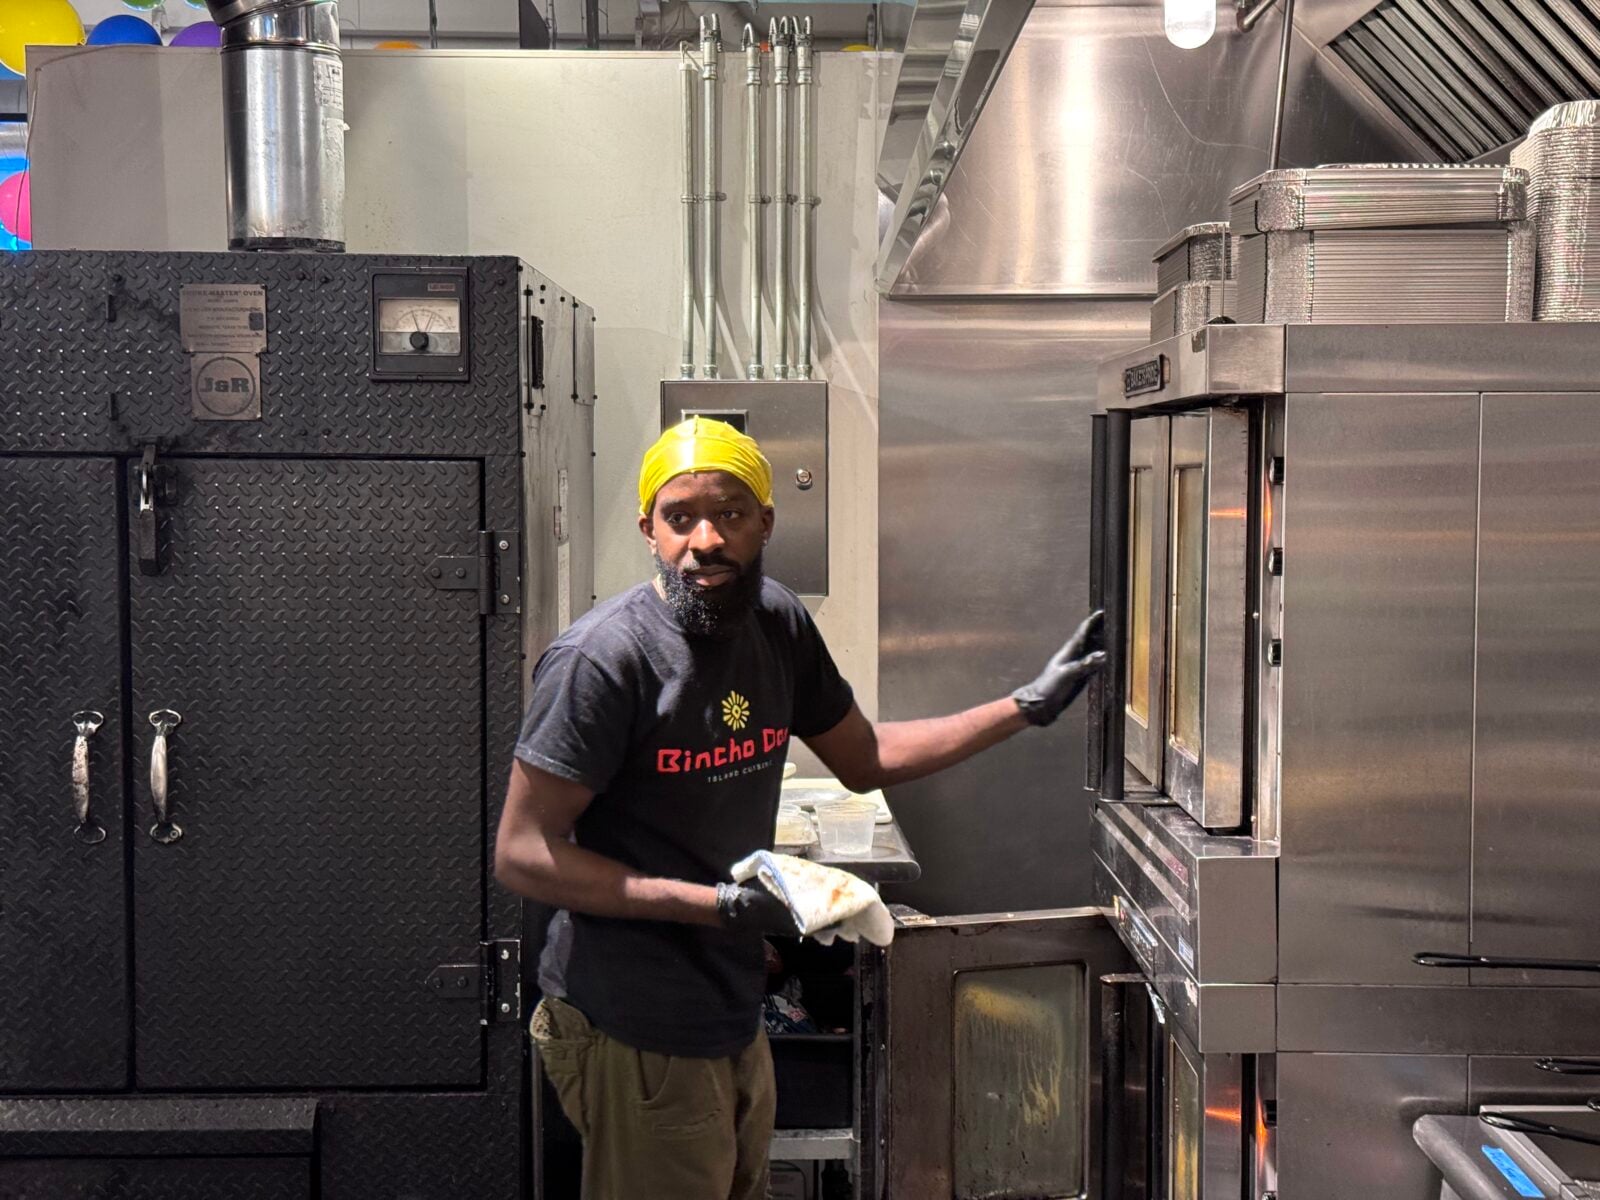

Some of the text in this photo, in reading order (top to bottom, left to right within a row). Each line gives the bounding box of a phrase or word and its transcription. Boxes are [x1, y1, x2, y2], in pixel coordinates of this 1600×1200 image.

[199, 377, 250, 393] J&R
[657, 738, 755, 772] Bincho
[707, 770, 740, 783] ISLAND
